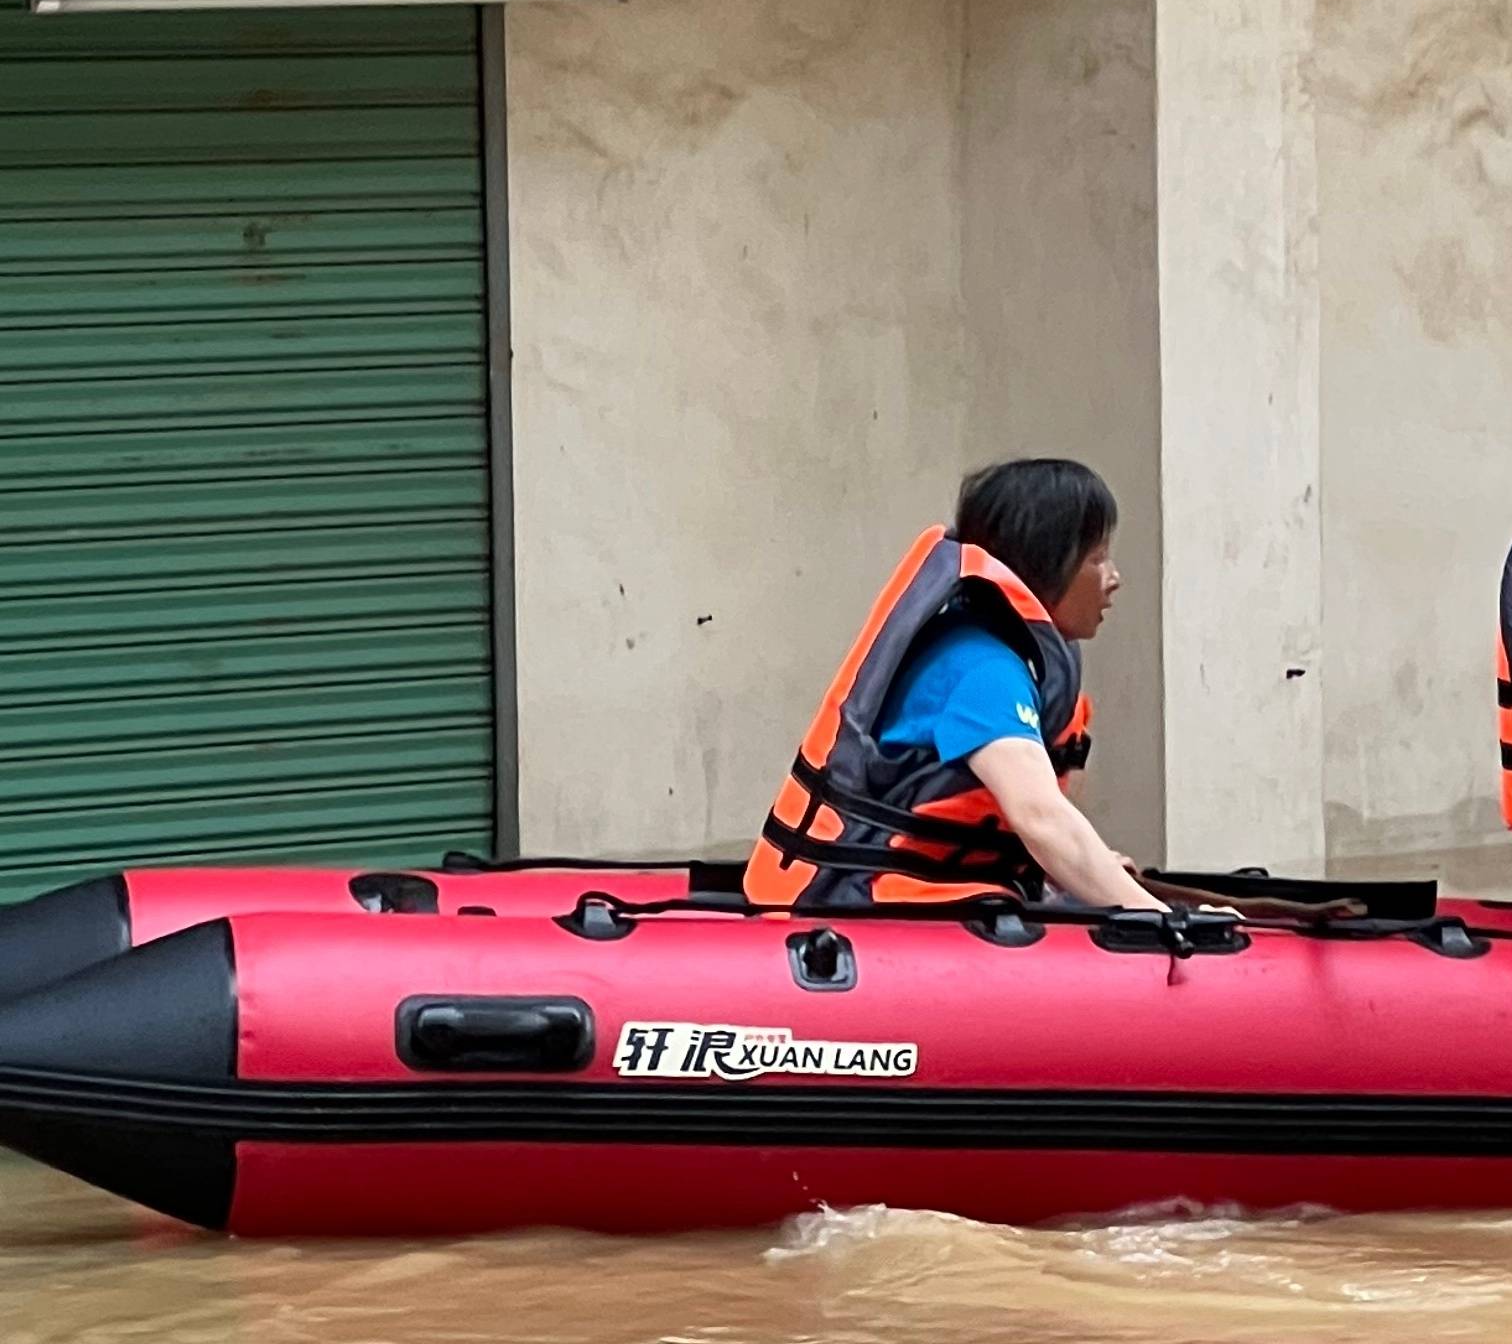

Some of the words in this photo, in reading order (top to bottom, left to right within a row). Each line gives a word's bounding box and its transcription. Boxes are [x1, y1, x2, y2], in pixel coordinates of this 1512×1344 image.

[620, 1027, 756, 1074] 轩浪
[739, 1043, 823, 1069] XUAN
[833, 1047, 914, 1071] LANG
